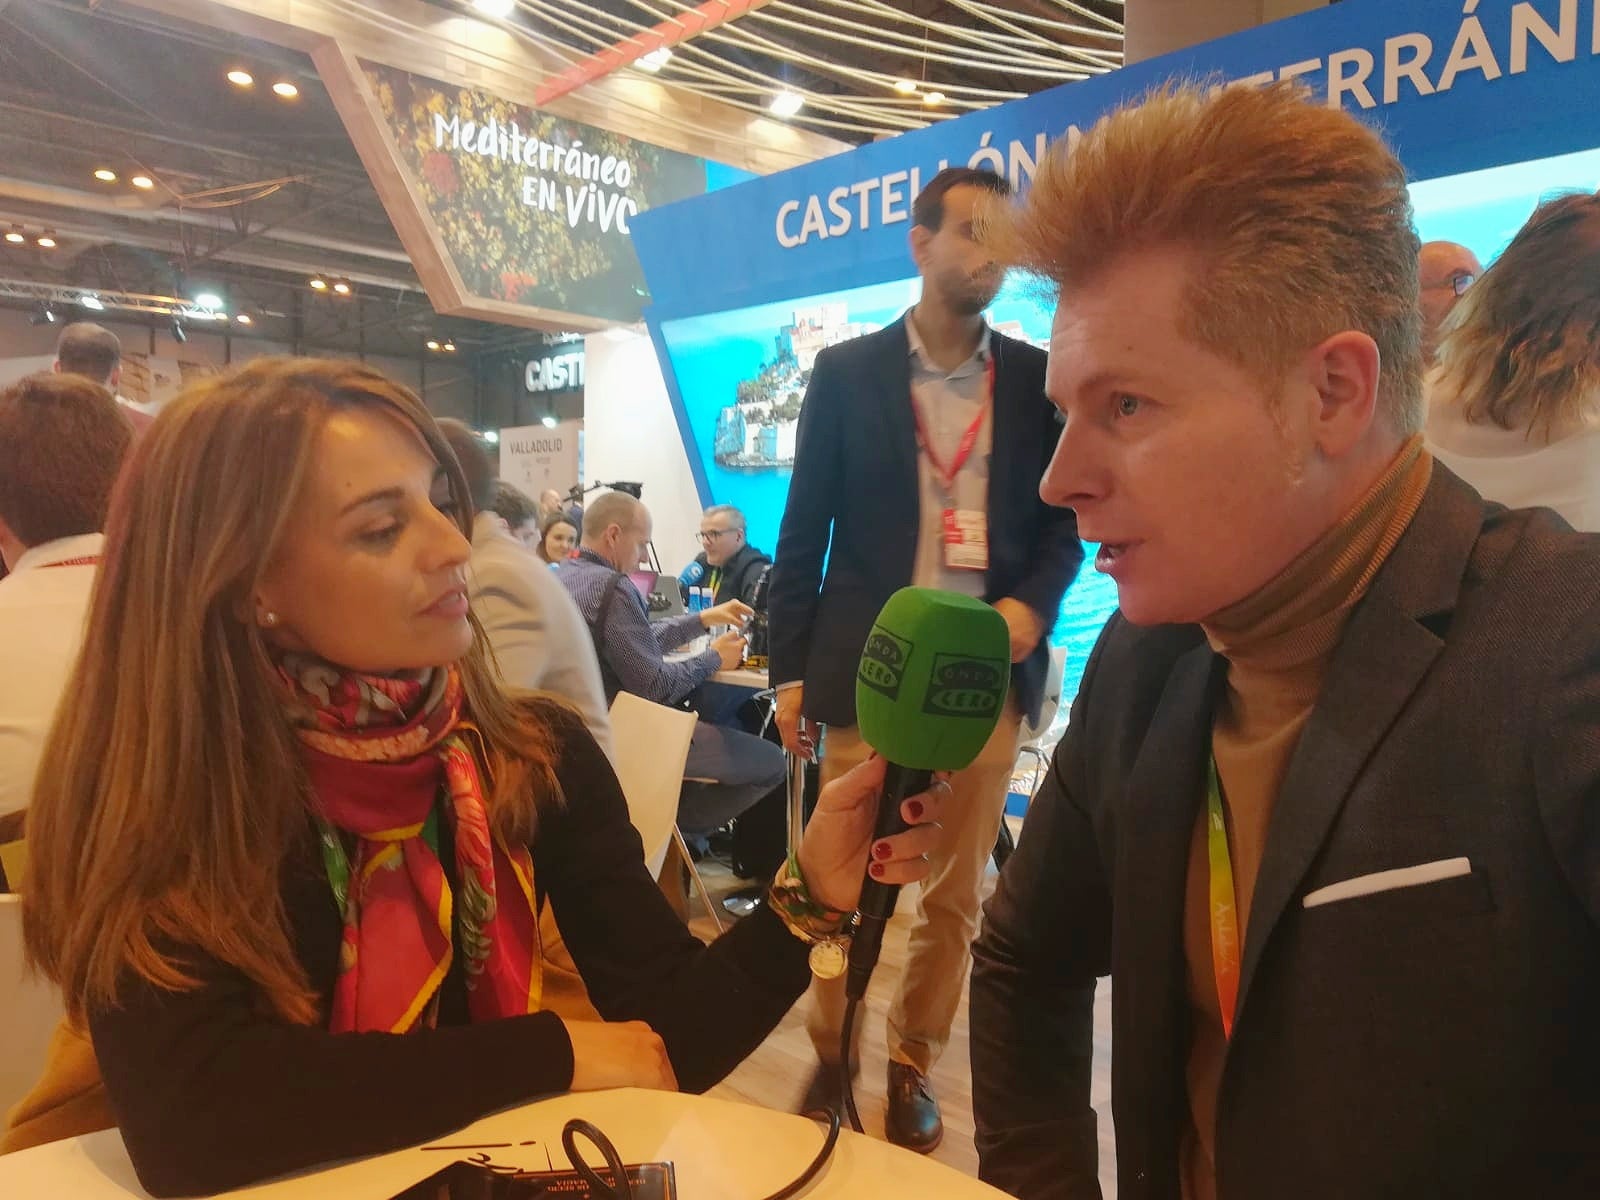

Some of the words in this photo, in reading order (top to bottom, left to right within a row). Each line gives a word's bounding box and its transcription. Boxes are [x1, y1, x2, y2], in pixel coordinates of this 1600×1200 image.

[433, 112, 631, 188] Mediterráneo
[522, 176, 556, 212] EN
[775, 131, 1047, 248] CASTELÓN
[510, 438, 562, 455] VALLADOLID
[862, 661, 892, 685] CERO
[942, 691, 993, 708] CERO
